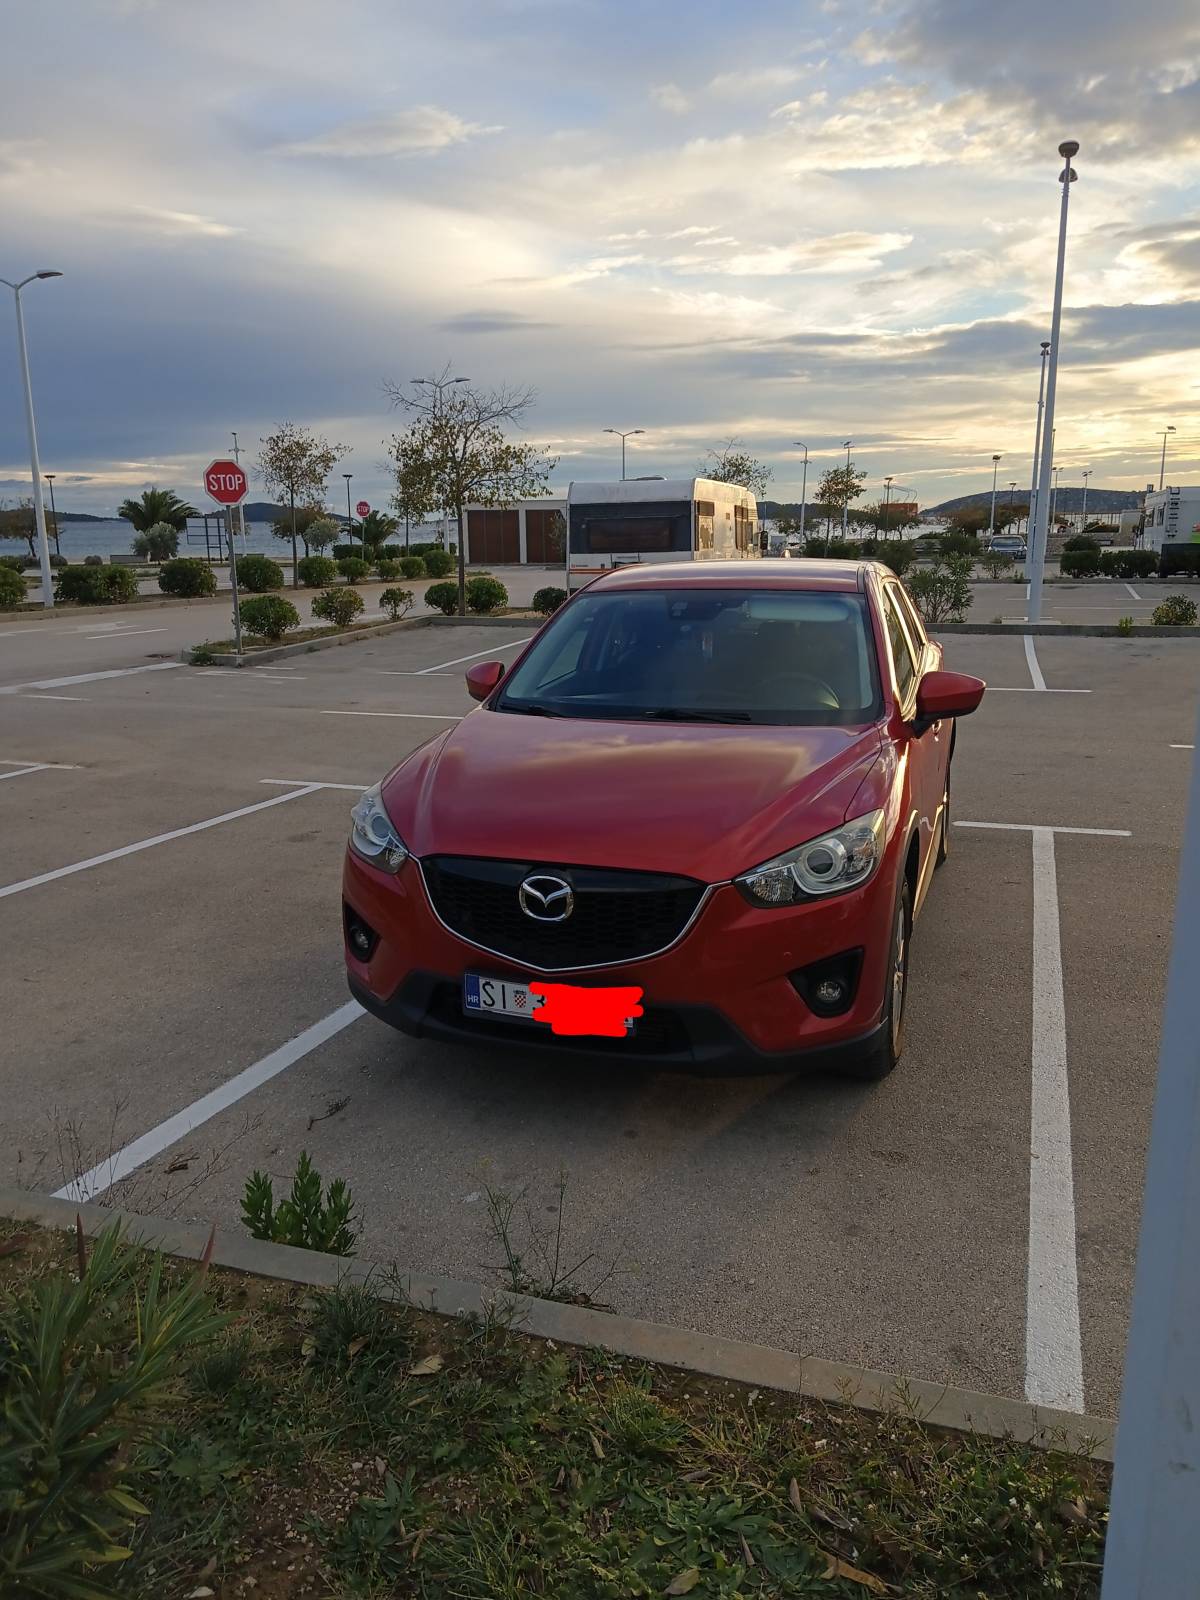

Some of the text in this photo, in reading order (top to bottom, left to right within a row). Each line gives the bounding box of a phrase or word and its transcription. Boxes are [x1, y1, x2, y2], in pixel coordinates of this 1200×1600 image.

[209, 474, 243, 491] STOP
[357, 505, 369, 513] STOP
[467, 994, 480, 1004] HR
